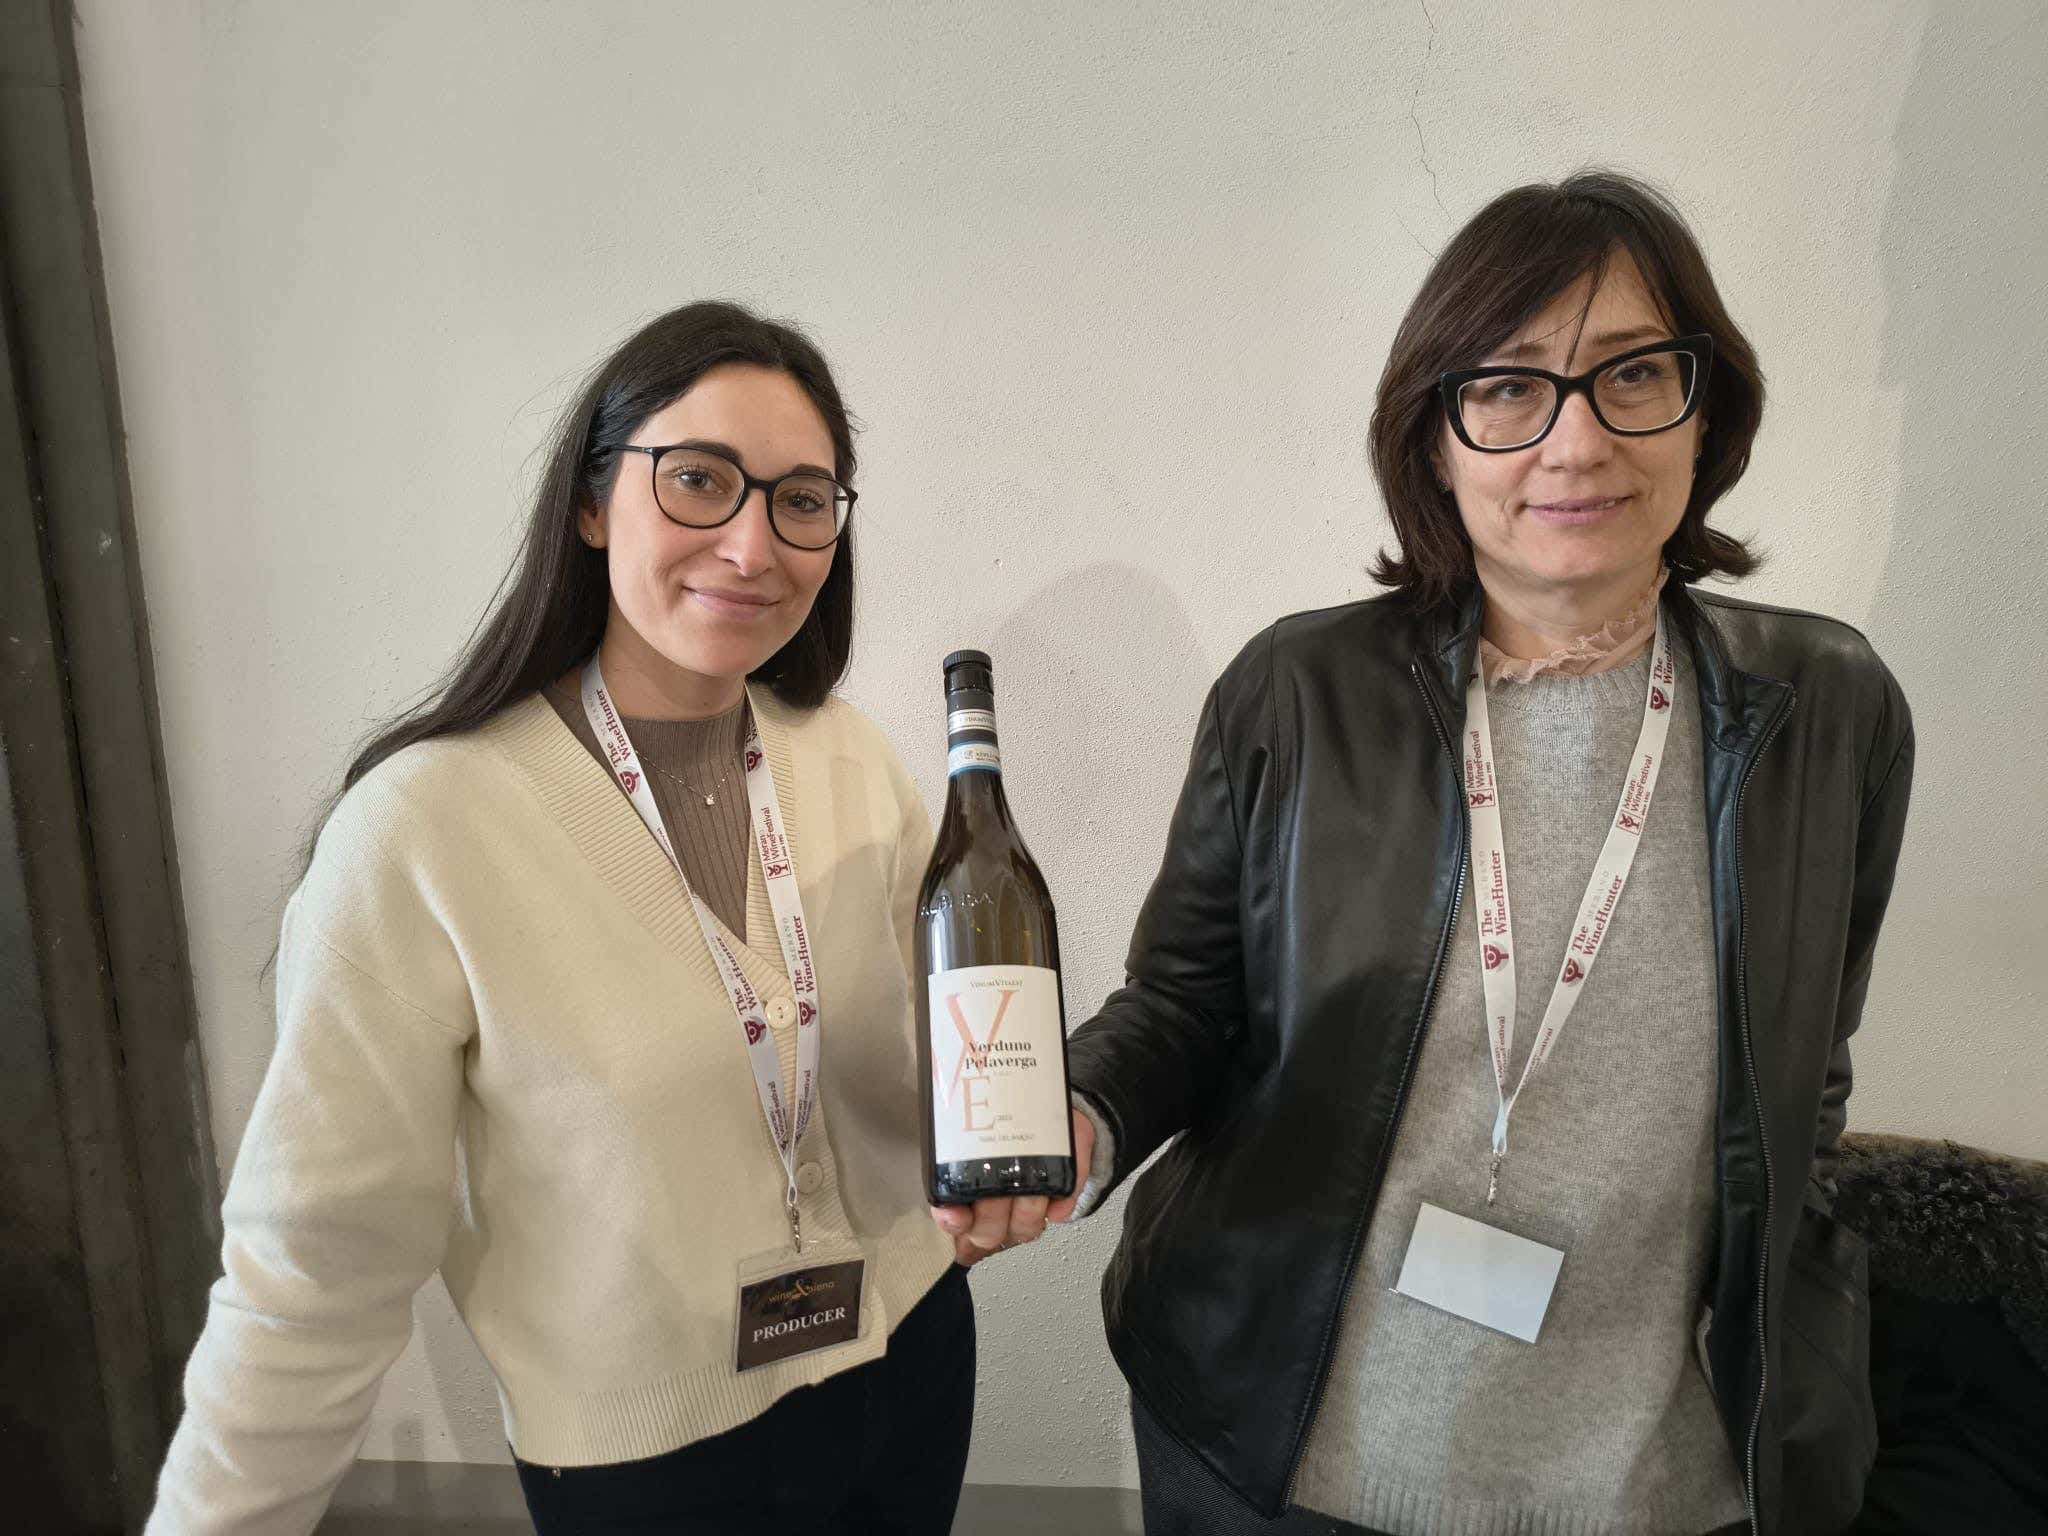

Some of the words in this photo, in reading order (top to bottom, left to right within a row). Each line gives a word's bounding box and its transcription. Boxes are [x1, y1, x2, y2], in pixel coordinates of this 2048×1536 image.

[1653, 656, 1663, 680] The
[595, 688, 631, 762] WineHunter
[607, 742, 621, 768] The
[1469, 730, 1485, 788] WineFestival
[1465, 759, 1475, 789] Meran
[1630, 754, 1653, 813] WineFestival
[1623, 779, 1637, 810] Meran
[759, 834, 770, 862] Meran
[761, 806, 780, 860] WineFestival
[1491, 850, 1507, 936] WineHunter
[1481, 908, 1494, 937] The
[1582, 875, 1623, 956] WineHunter
[1572, 925, 1589, 952] The
[793, 915, 815, 993] WineHunter
[716, 935, 757, 1011] WineHunter
[794, 968, 805, 995] The
[734, 987, 748, 1016] The
[969, 1039, 1032, 1053] Verduno
[965, 1055, 1037, 1070] Pelaverga
[753, 1306, 846, 1343] PRODUCER
